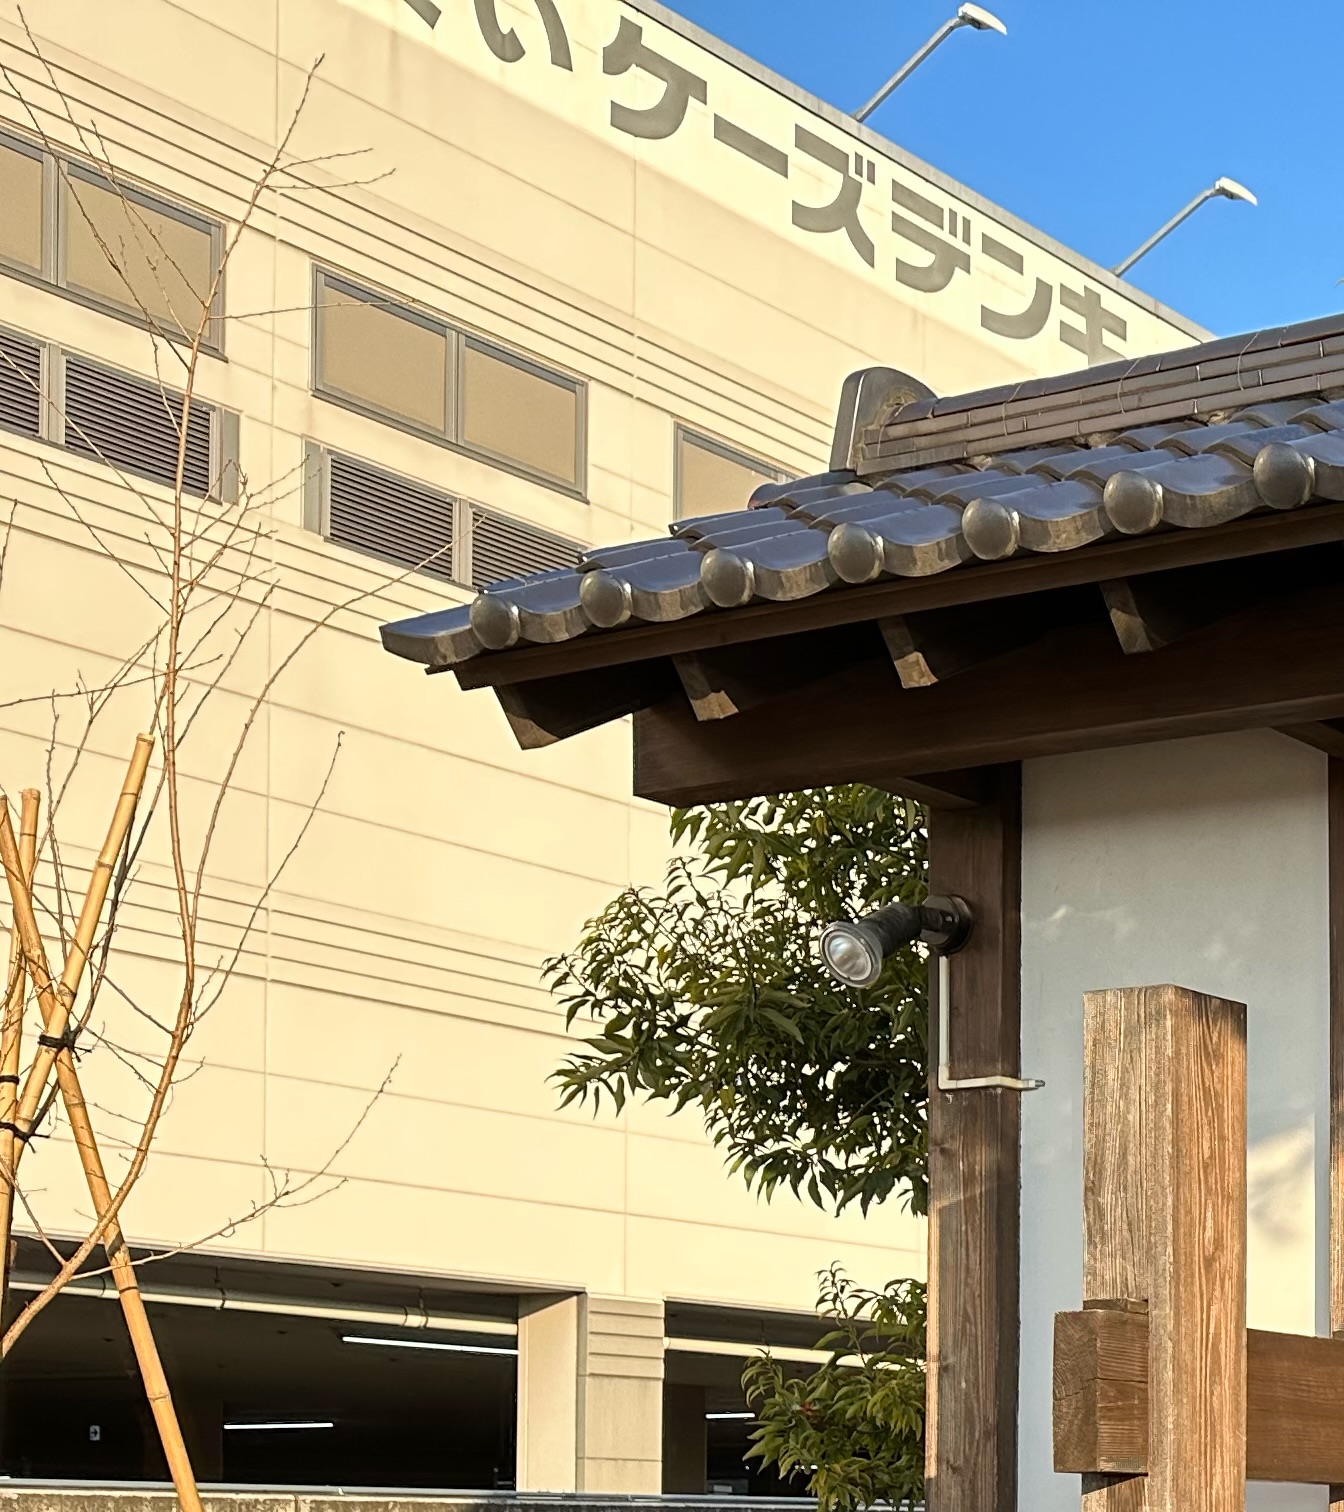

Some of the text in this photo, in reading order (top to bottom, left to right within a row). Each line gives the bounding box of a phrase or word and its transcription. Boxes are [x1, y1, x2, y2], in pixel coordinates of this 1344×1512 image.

[405, 0, 1127, 368] いケーズデンキ
